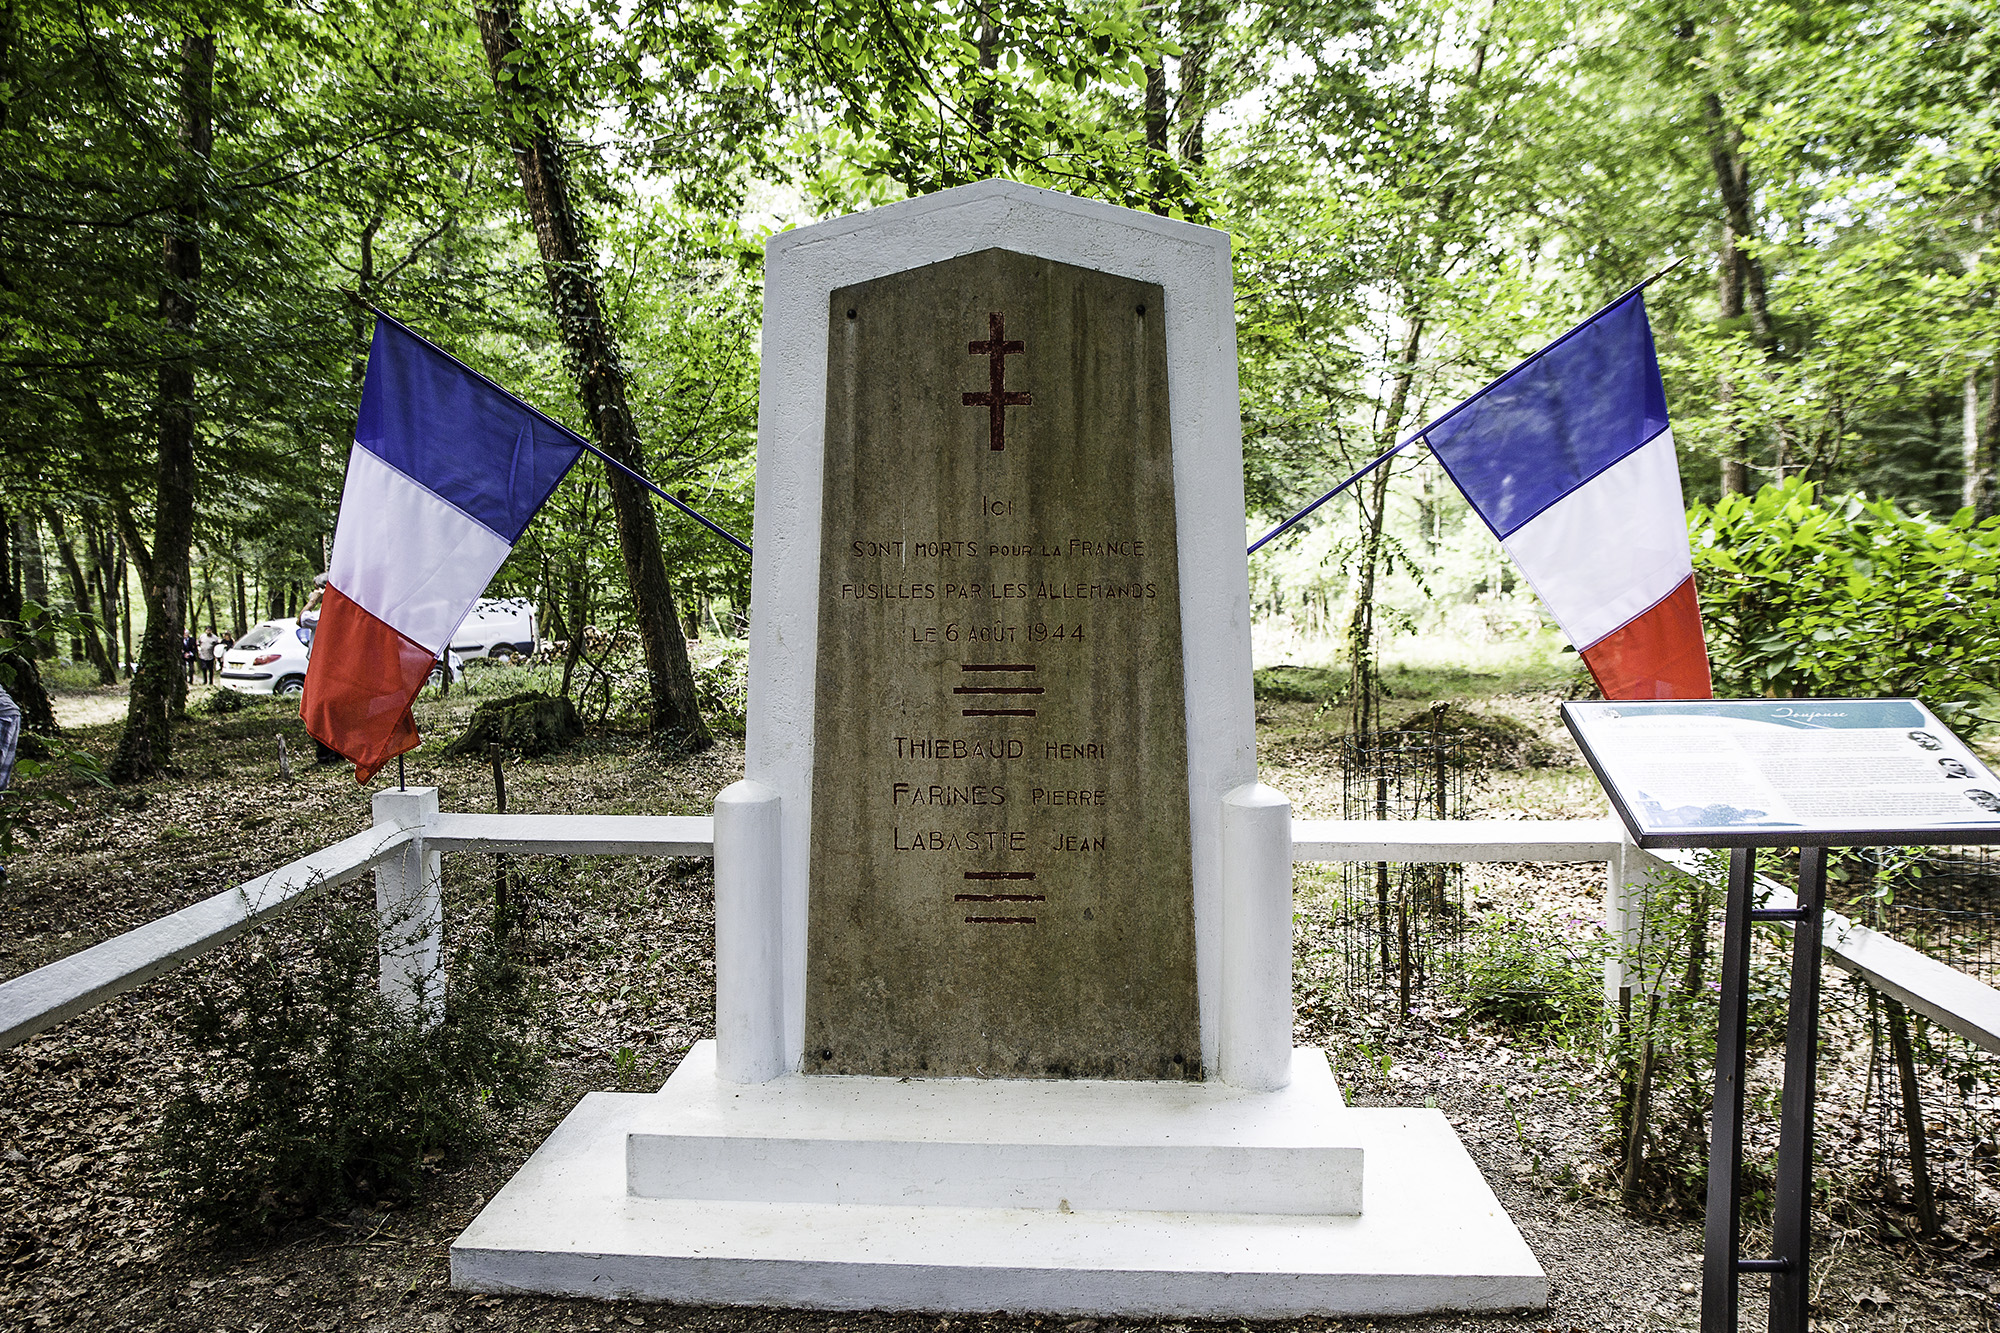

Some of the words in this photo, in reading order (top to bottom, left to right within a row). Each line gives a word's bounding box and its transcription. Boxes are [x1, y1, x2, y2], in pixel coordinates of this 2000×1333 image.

[853, 541, 903, 557] SONT
[915, 541, 978, 557] MORTS
[989, 545, 1032, 557] POUR
[1042, 545, 1061, 557] LA
[1069, 539, 1145, 557] FRANCE
[842, 584, 935, 599] FUSILLES
[946, 583, 982, 599] PAR
[992, 583, 1027, 599] LES
[1037, 581, 1157, 599] ALLEMANDS
[913, 627, 936, 642] LE
[945, 624, 959, 642] 6
[968, 621, 1017, 642] AOÛT
[1027, 624, 1085, 642] 1944
[894, 737, 1023, 759] THIEBAUD
[1045, 741, 1105, 759] HENRI
[893, 783, 1005, 805] FARINES
[1032, 788, 1105, 806] PIERRE
[894, 828, 1026, 851] LABASTIE
[1053, 834, 1106, 851] JEAN
